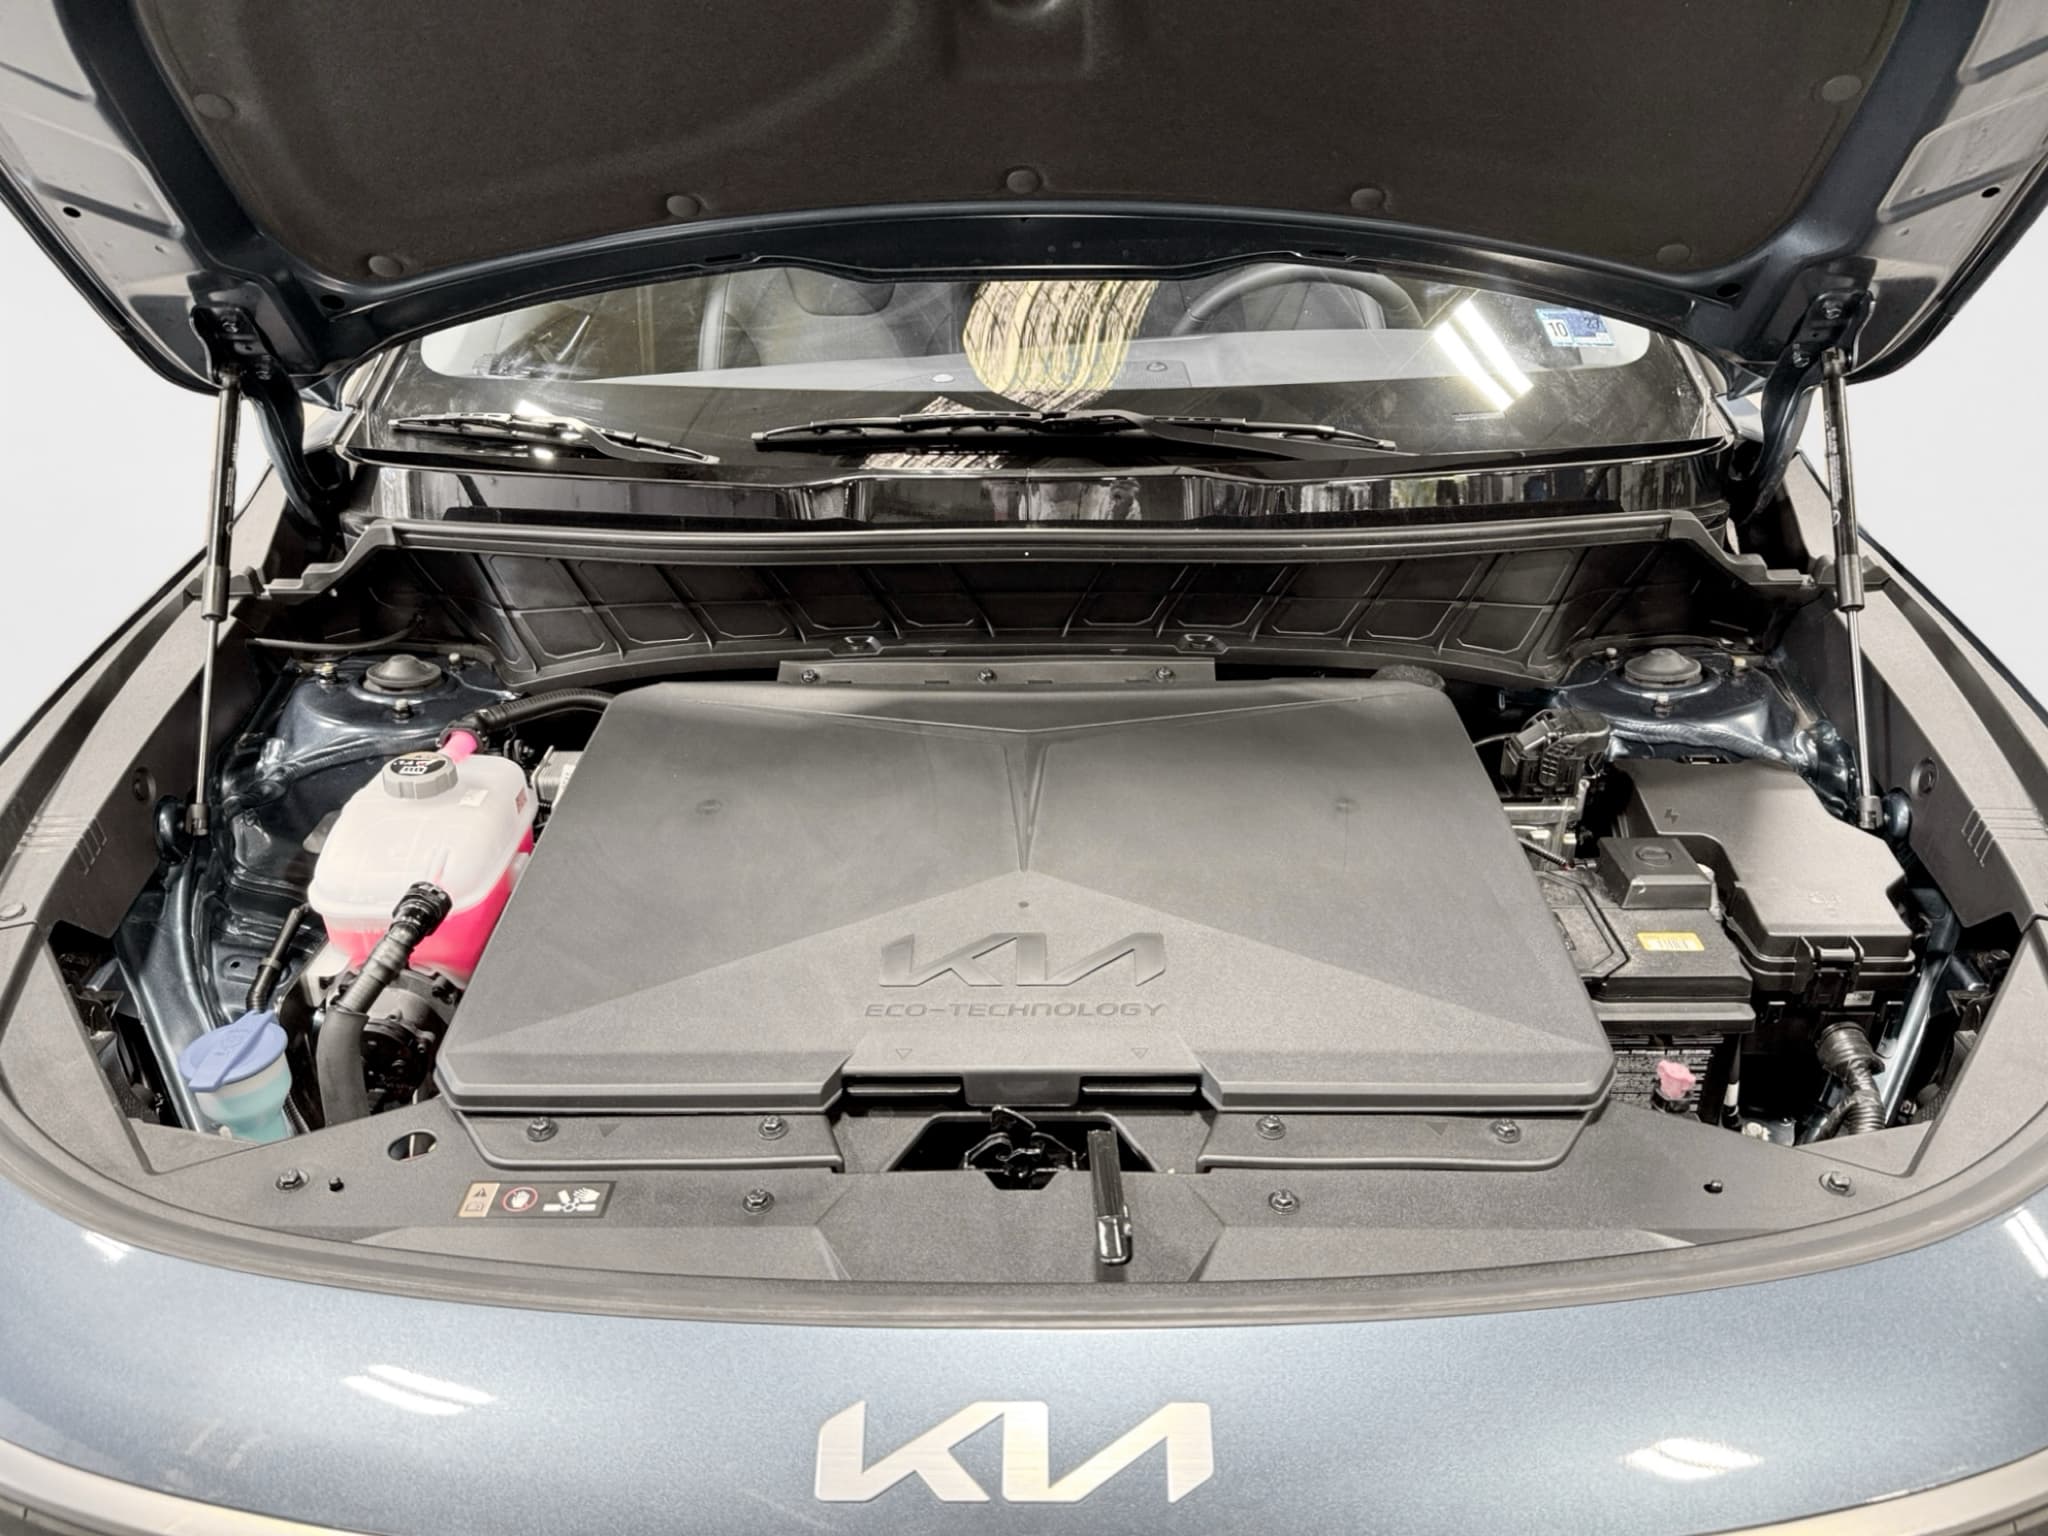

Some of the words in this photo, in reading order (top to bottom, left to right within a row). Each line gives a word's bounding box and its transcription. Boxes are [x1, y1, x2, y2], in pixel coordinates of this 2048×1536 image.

[1547, 321, 1569, 338] 10
[879, 932, 1166, 987] KIA
[864, 1002, 1166, 1018] ECO-TECHNOLOGY
[814, 1400, 1214, 1504] KIA
